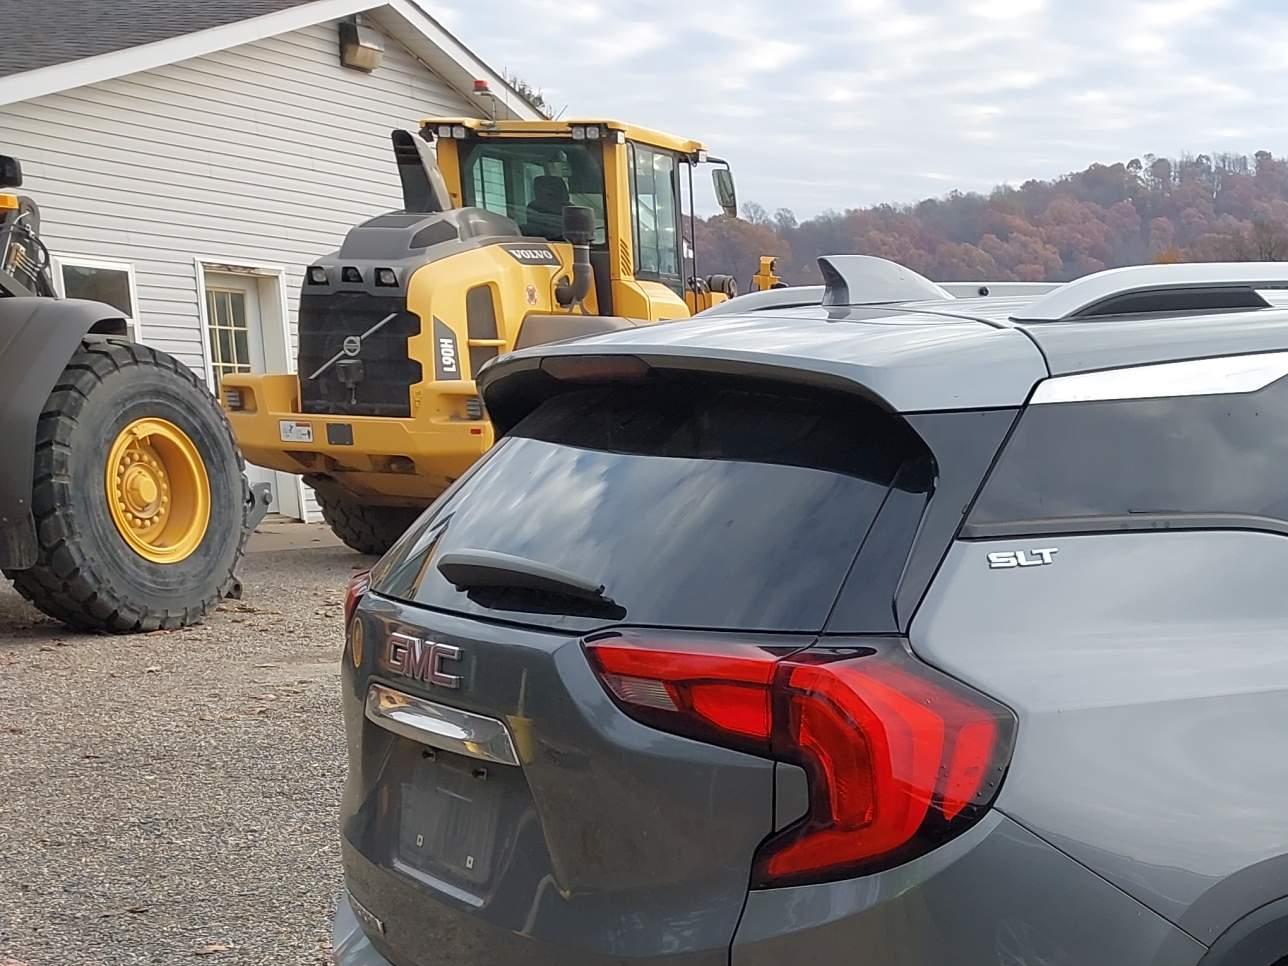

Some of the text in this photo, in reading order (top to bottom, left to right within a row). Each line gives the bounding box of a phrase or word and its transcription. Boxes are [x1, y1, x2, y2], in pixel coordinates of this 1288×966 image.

[508, 249, 553, 259] VOLVO
[440, 338, 457, 372] L90H
[987, 547, 1059, 569] SLT
[386, 631, 463, 688] GMC
